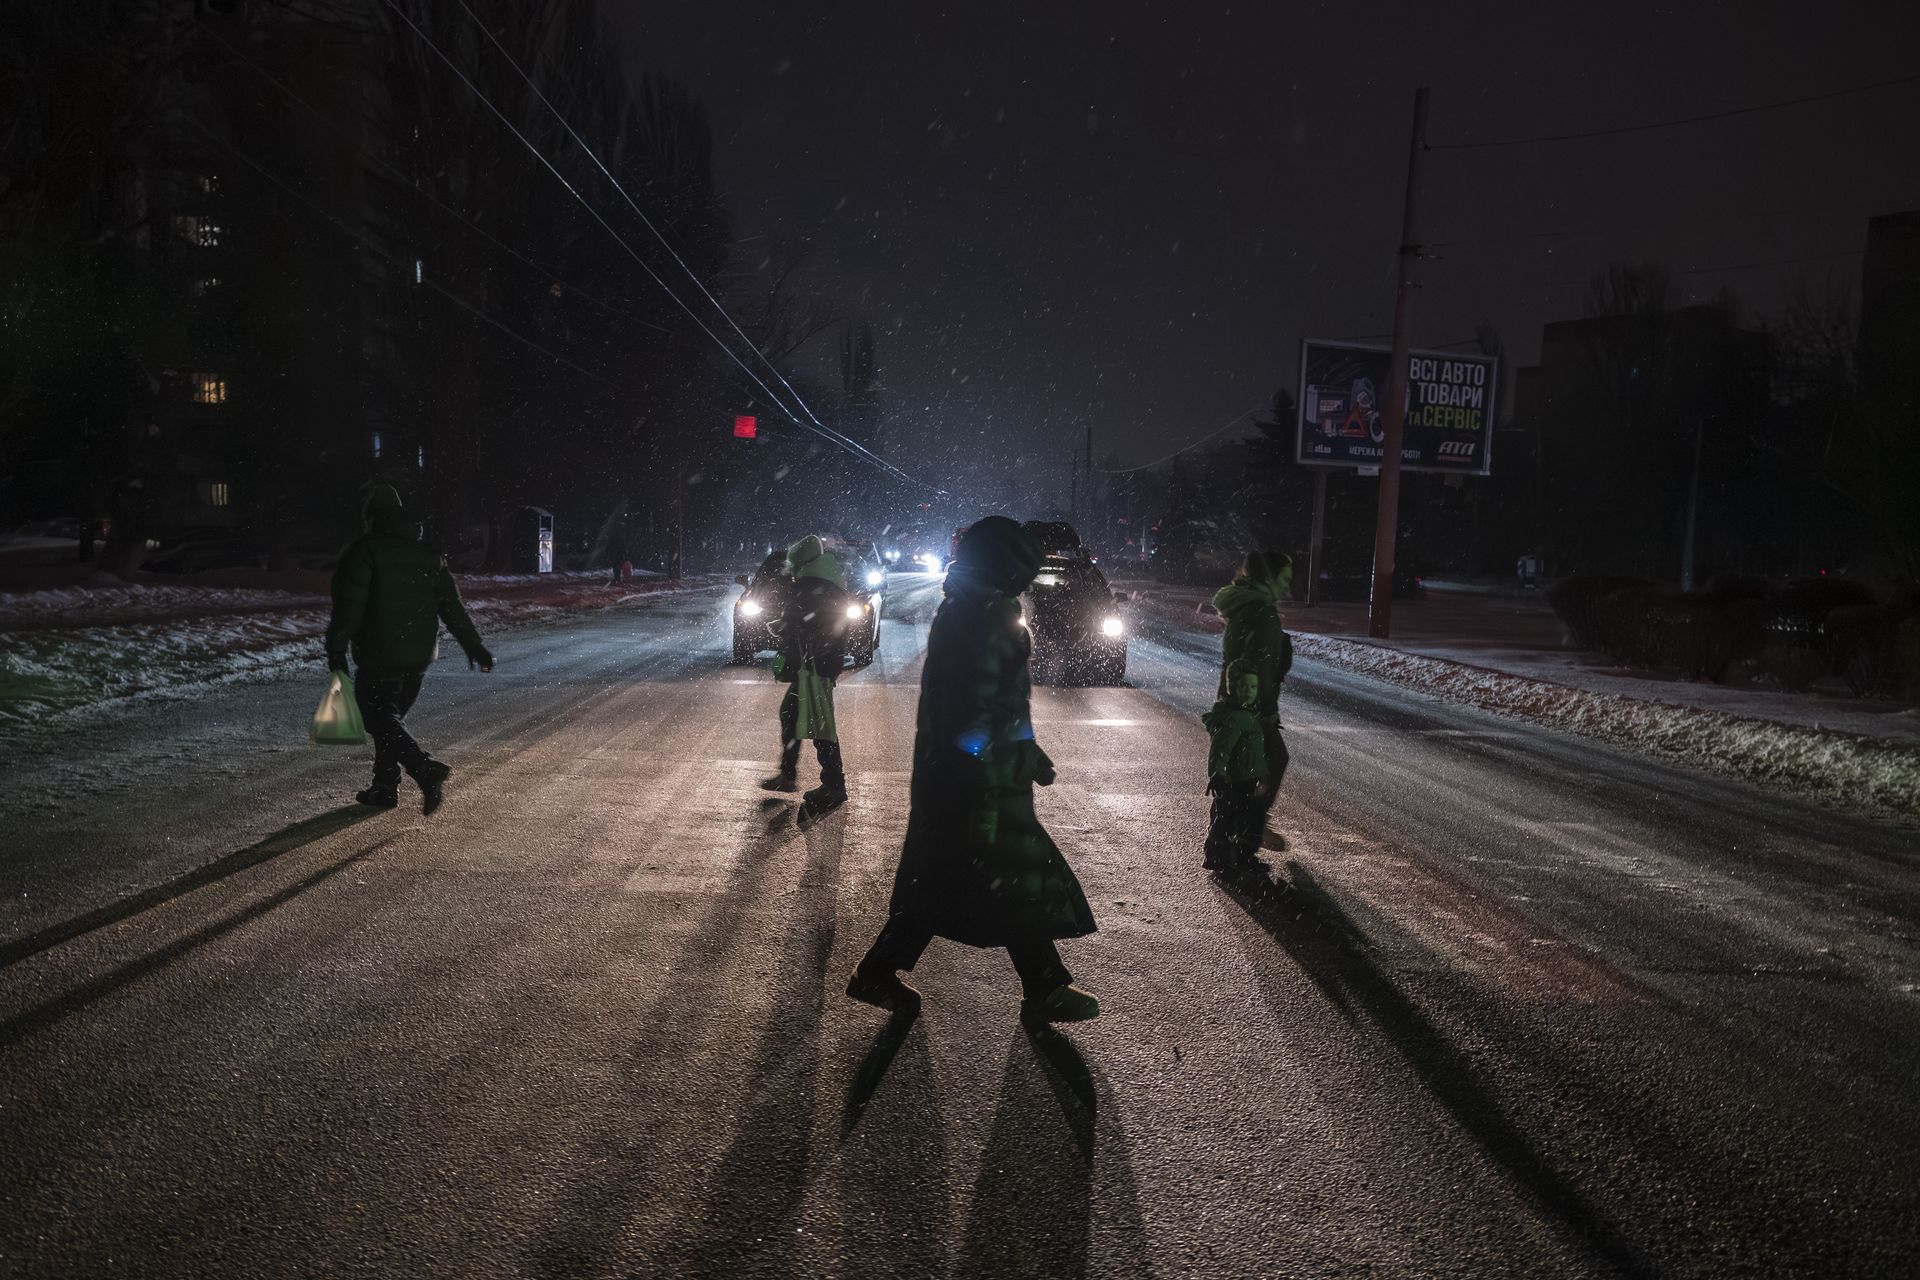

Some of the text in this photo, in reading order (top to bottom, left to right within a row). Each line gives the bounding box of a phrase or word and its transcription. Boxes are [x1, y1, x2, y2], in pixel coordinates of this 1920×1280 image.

[1410, 358, 1485, 386] ВСІ АВТО
[1417, 382, 1483, 408] ТОВАРИ
[1408, 405, 1481, 430] ТА СЕРВІС
